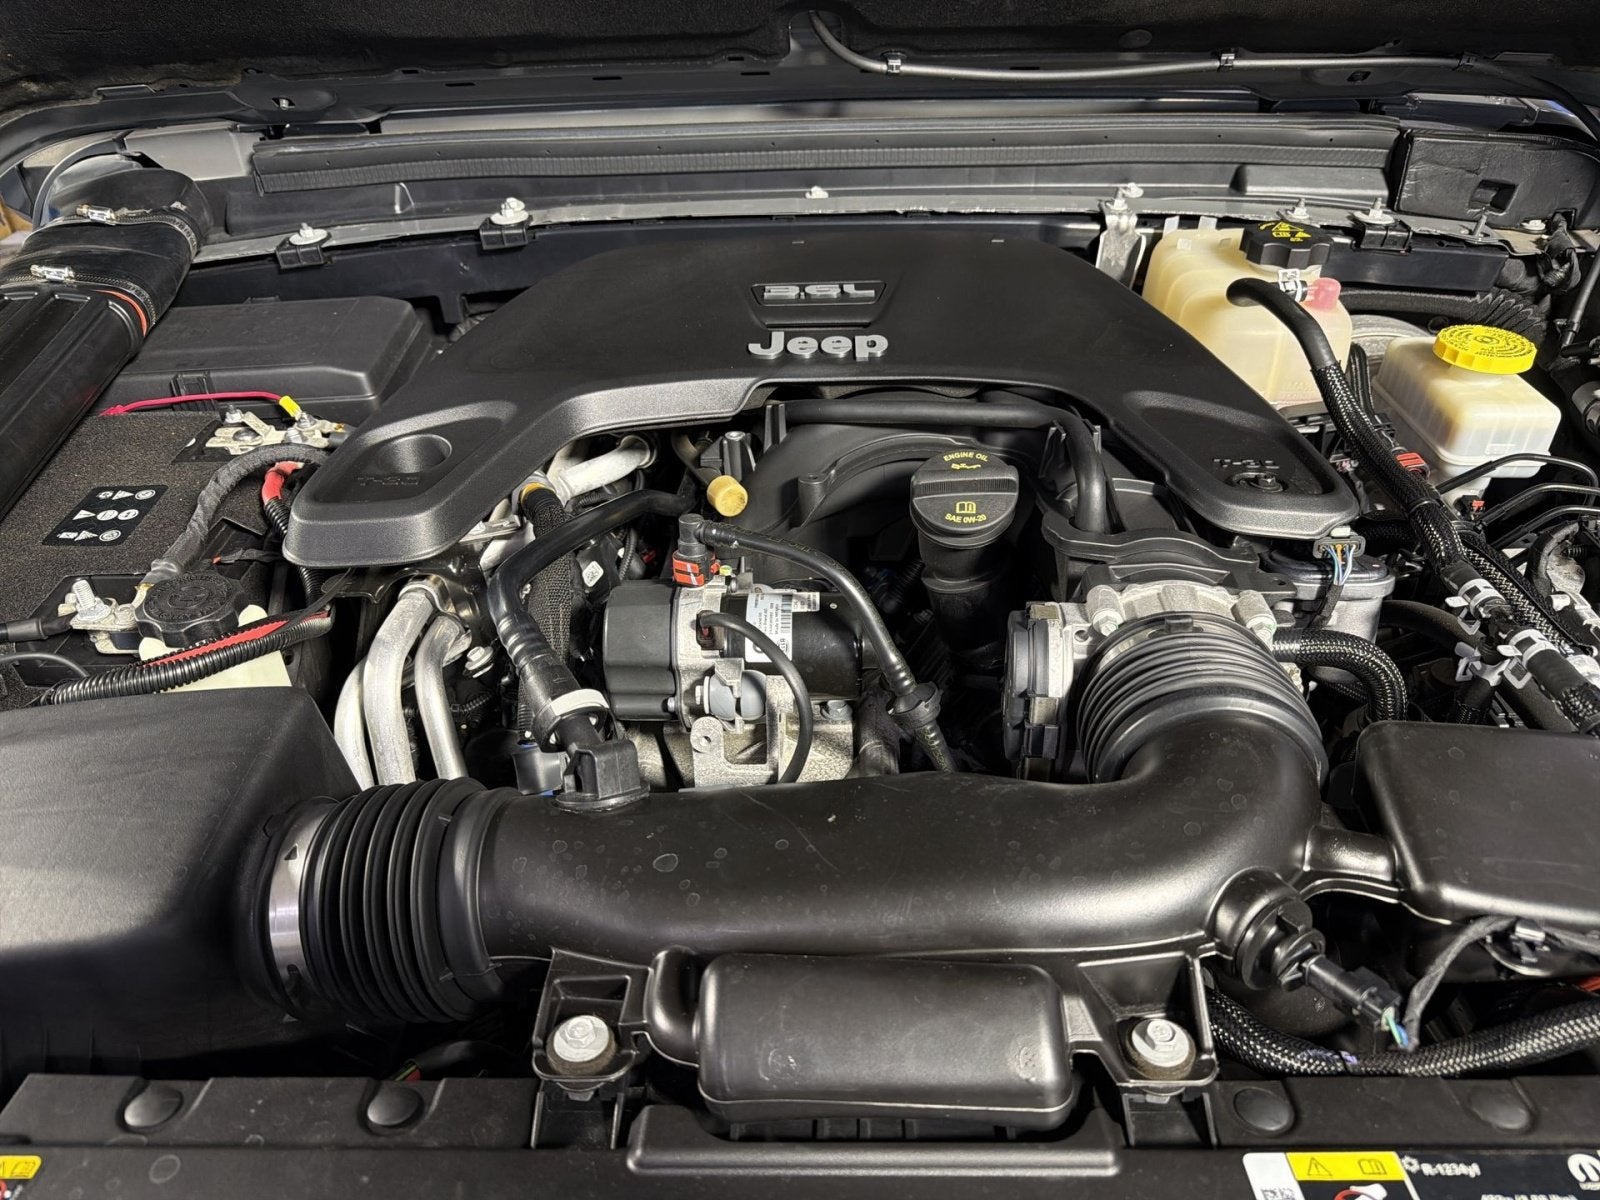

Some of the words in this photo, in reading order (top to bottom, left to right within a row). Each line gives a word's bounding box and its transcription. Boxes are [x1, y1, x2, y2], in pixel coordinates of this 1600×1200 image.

[748, 331, 889, 362] Jeep
[943, 451, 974, 462] ENGINE
[975, 453, 989, 462] OIL
[945, 513, 962, 523] SAE
[963, 514, 987, 524] 0W-20
